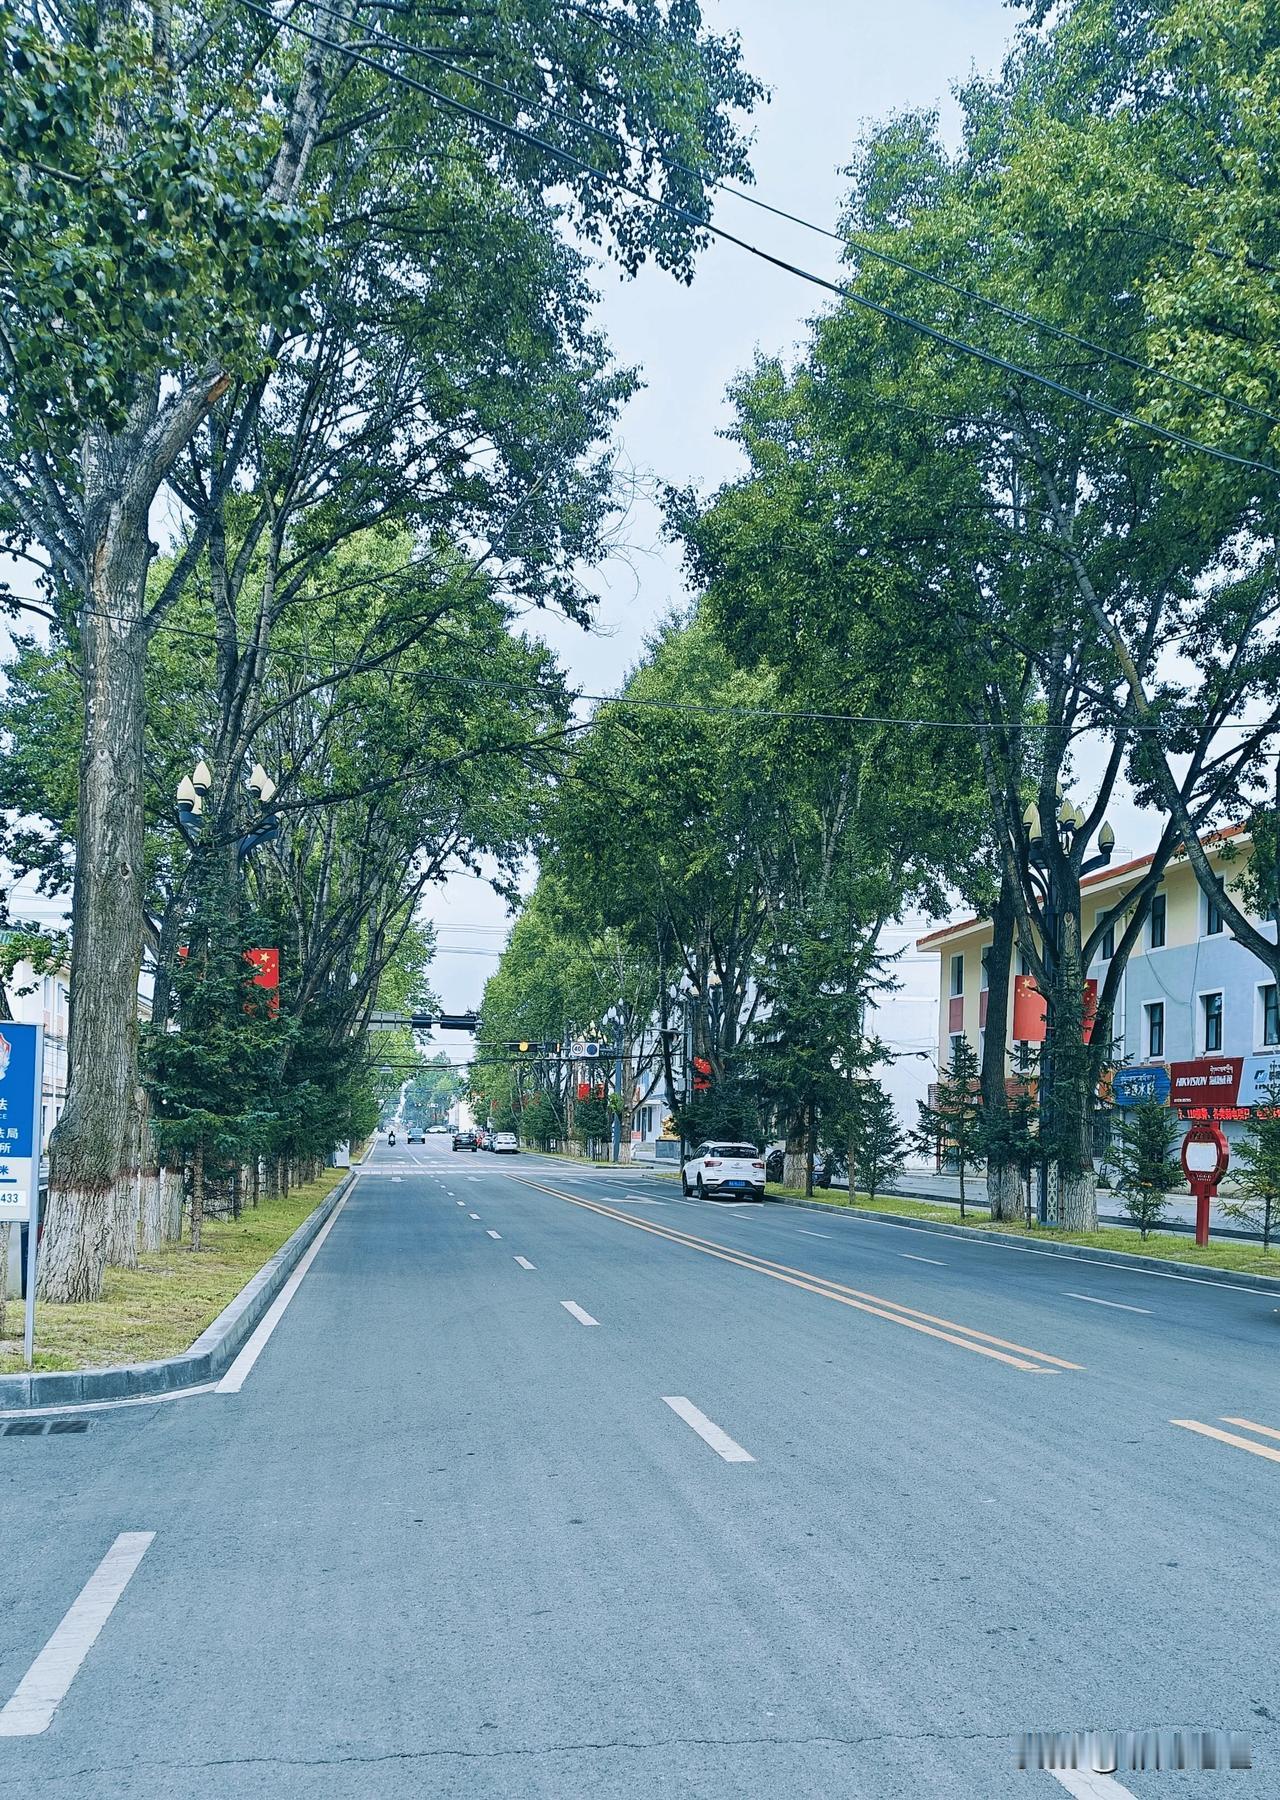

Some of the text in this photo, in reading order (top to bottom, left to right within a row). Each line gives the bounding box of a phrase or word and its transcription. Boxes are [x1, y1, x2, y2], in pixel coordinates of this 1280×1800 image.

[1175, 1076, 1208, 1087] HIKVISION
[0, 1164, 9, 1175] 米
[0, 1193, 18, 1203] 433
